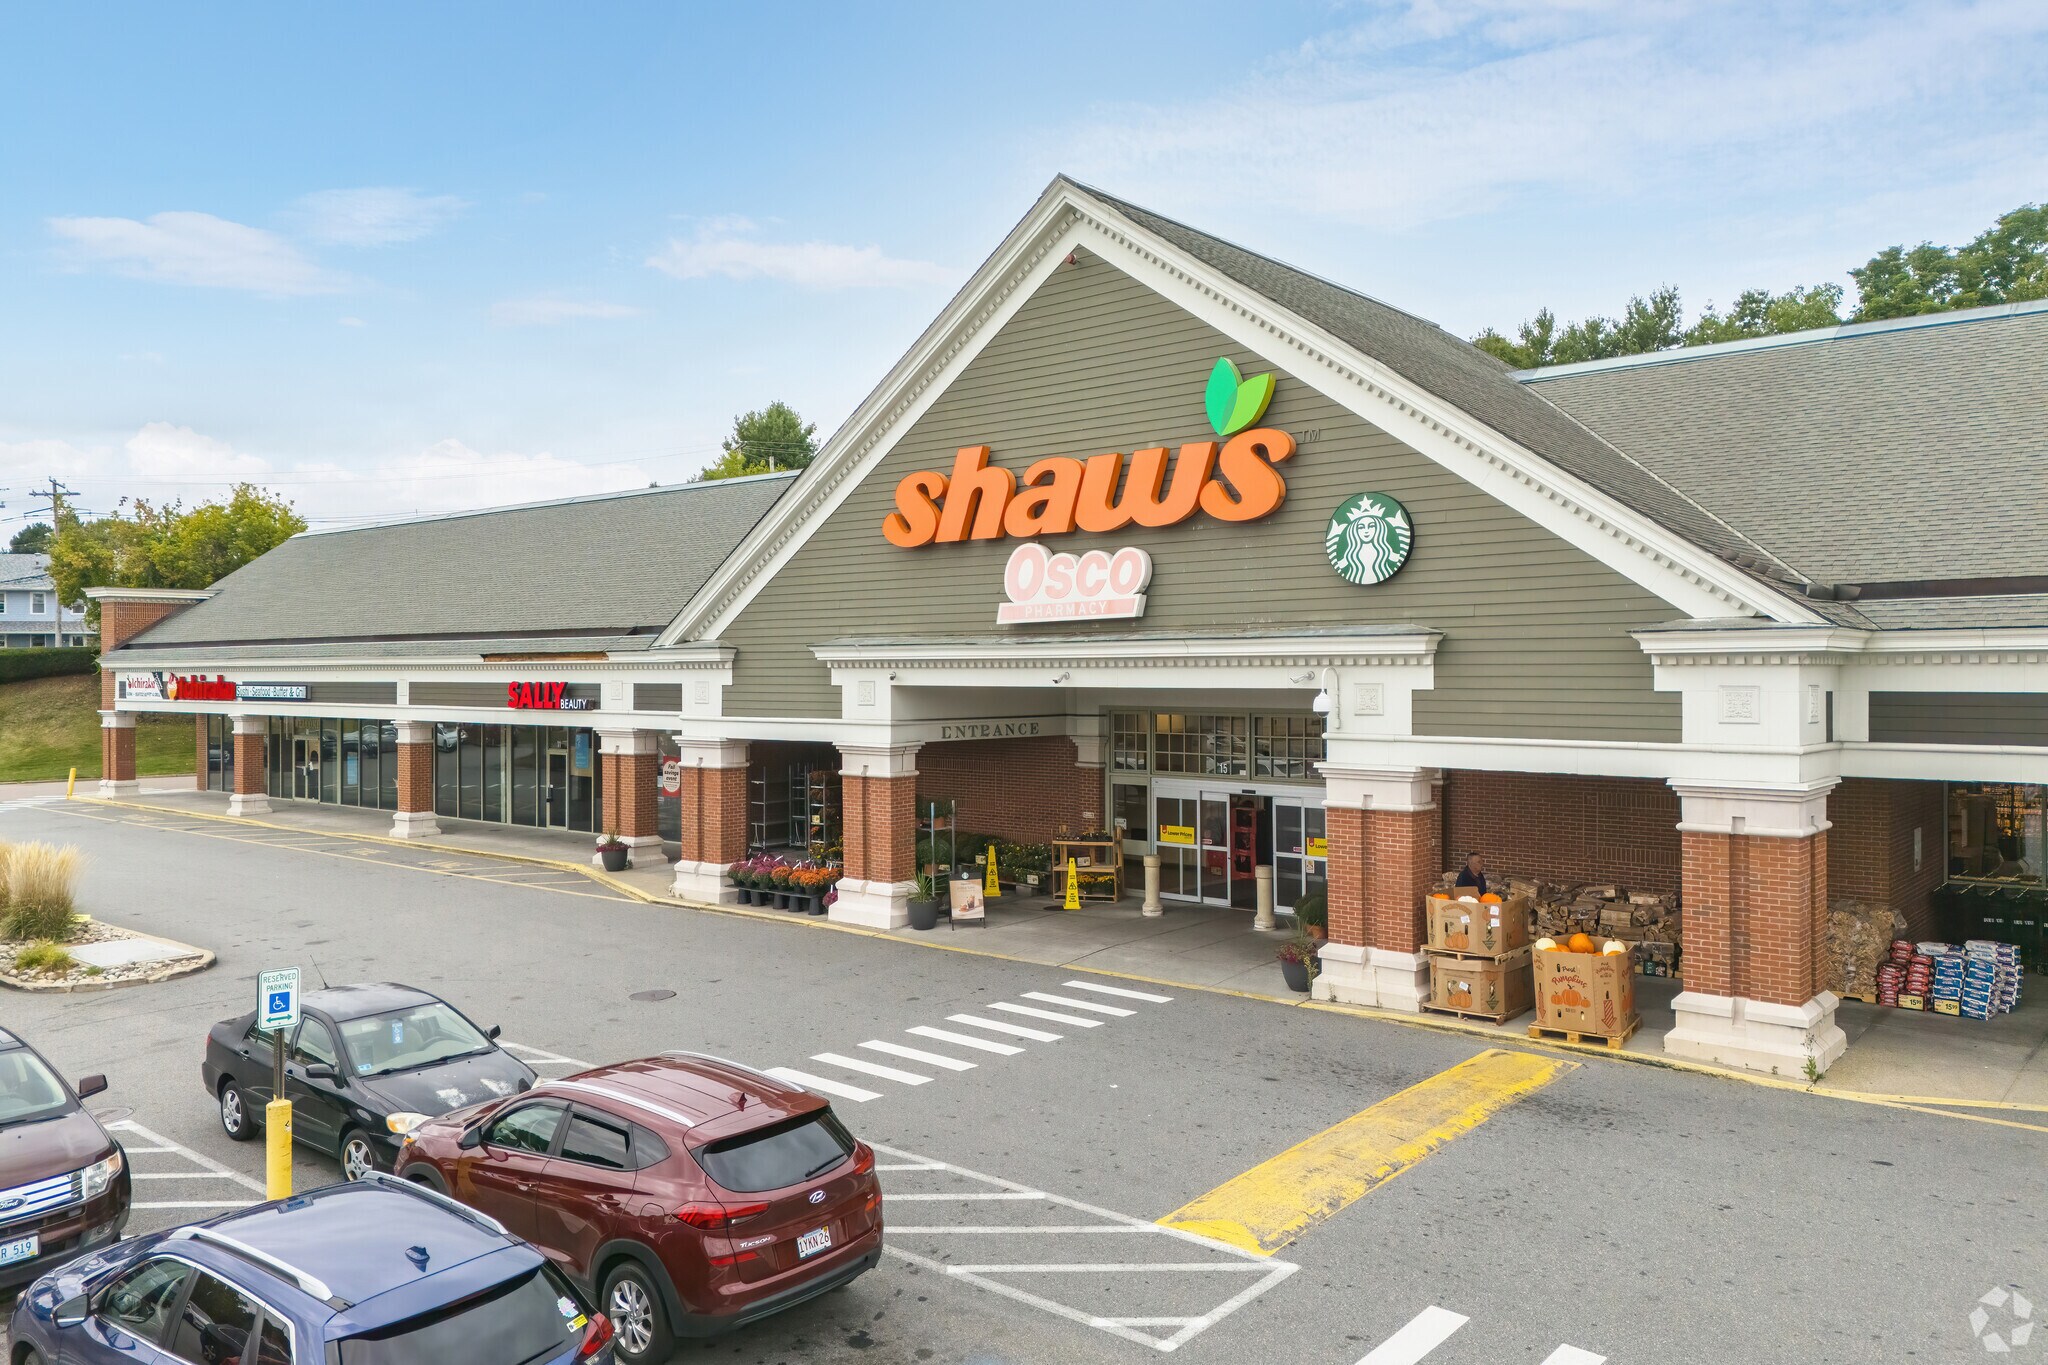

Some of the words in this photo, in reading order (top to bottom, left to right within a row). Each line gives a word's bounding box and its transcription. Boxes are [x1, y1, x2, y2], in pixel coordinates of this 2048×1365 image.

[1025, 601, 1110, 619] PHARMACY
[507, 681, 567, 709] SALLY
[560, 699, 587, 710] BEAUTY
[941, 722, 1039, 739] ENTRANCE
[1219, 763, 1229, 774] 15
[263, 972, 296, 984] RESERVED
[266, 982, 293, 992] PARKING
[818, 1231, 830, 1245] 26
[14, 1242, 32, 1255] 519
